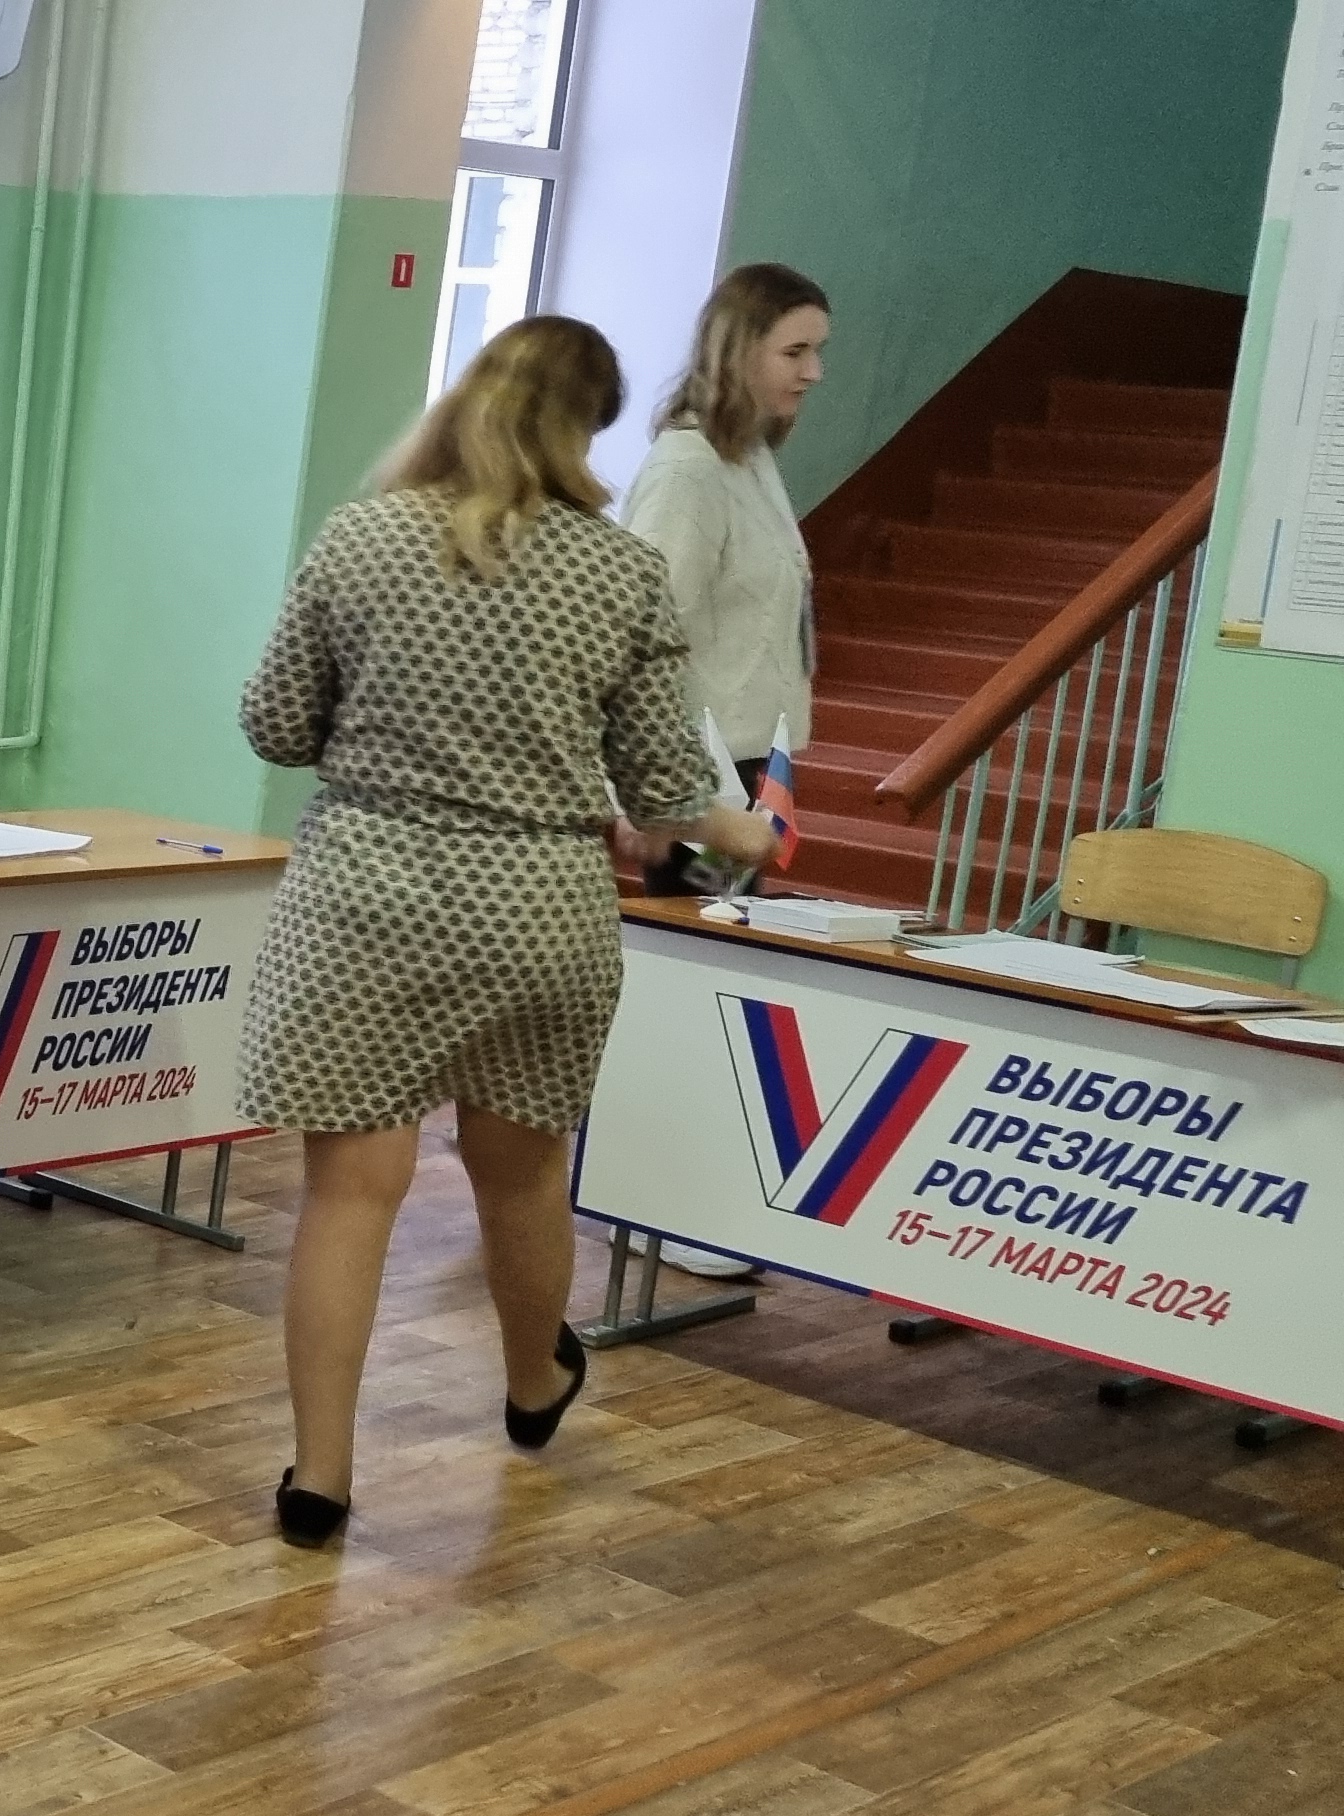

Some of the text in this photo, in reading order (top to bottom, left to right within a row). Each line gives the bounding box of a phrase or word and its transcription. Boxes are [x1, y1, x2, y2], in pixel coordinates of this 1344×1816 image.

[70, 918, 201, 966] ВЫБОРЫ
[51, 965, 231, 1020] ПРЕЗИДЕНТА
[31, 1023, 153, 1074] РОССИИ
[74, 1072, 148, 1112] МАРТА
[146, 1065, 197, 1102] 2024
[985, 1053, 1244, 1142] ВЫБОРЫ
[948, 1107, 1310, 1225] ПРЕЗИДЕНТА
[912, 1159, 1139, 1245] РОССИИ
[988, 1236, 1127, 1300] МАРТА
[1125, 1272, 1233, 1328] 2024
